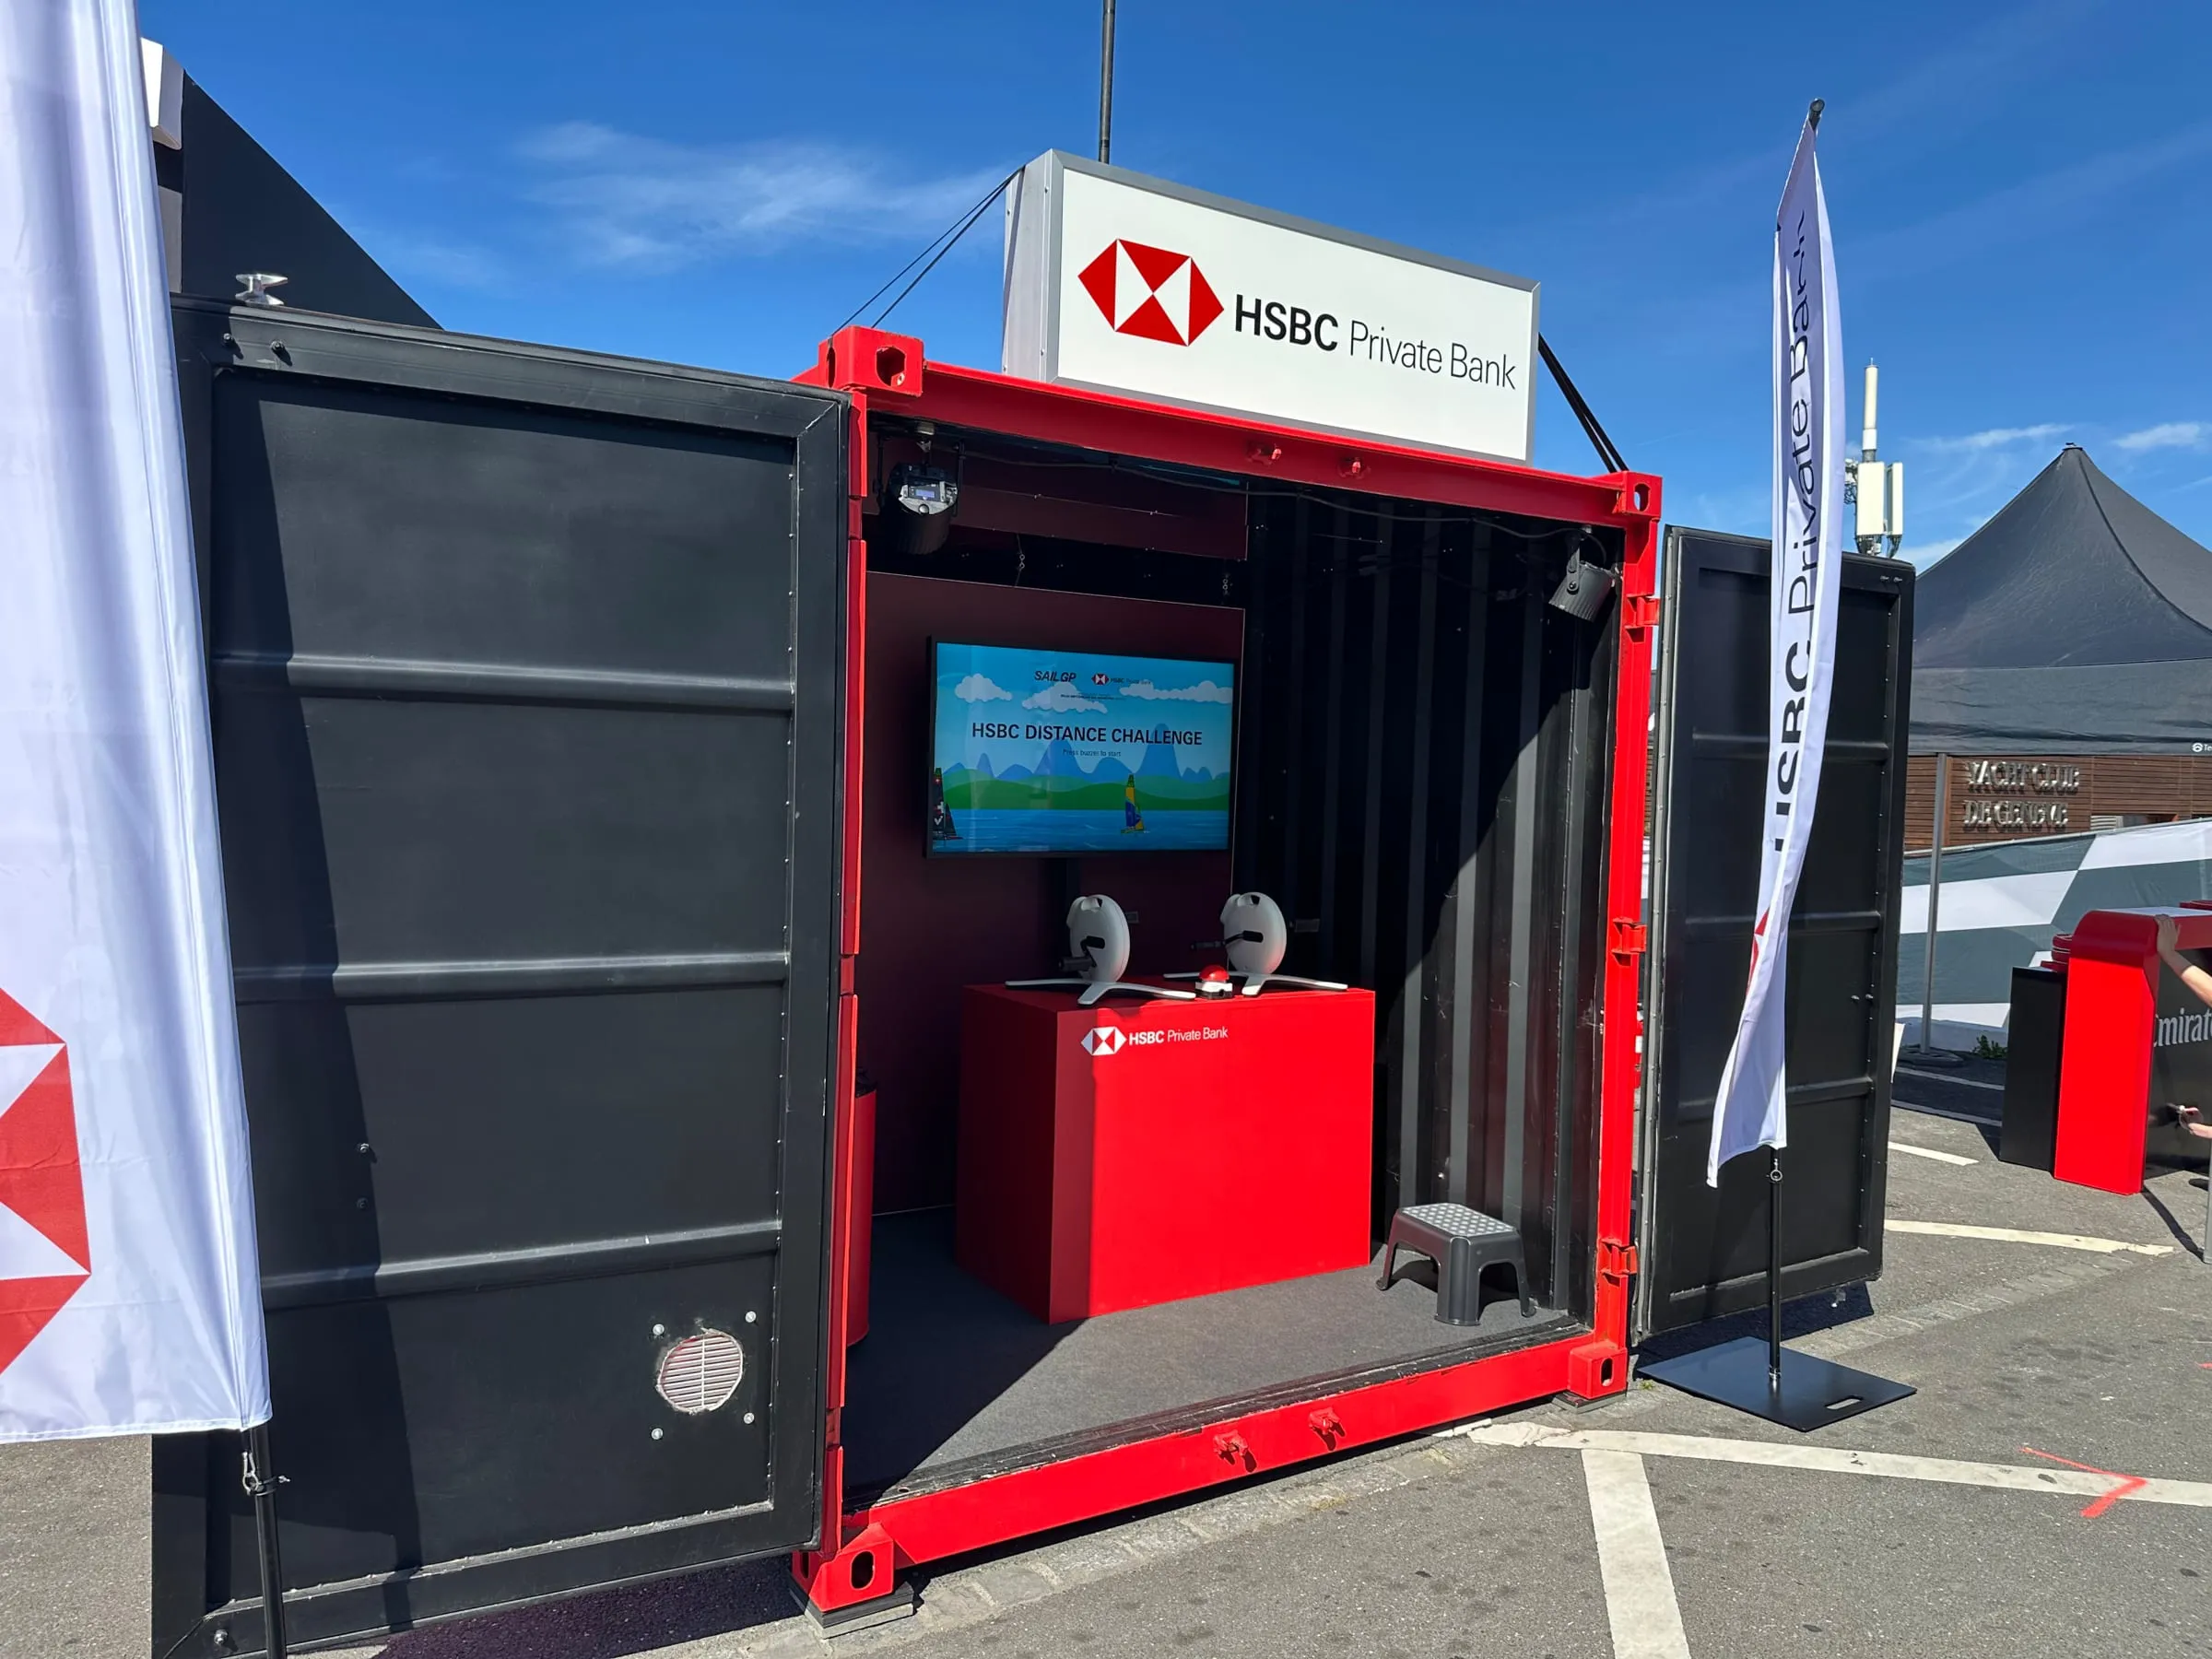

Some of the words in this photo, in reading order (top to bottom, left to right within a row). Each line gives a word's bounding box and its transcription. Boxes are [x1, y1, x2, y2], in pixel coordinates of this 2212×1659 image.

[1234, 294, 1338, 351] HSBC
[1349, 319, 1442, 374] Private
[1451, 344, 1516, 390] Bank
[1788, 399, 1818, 614] Private
[972, 723, 1020, 739] HSBC
[1025, 724, 1107, 742] DISTANCE
[1112, 728, 1203, 746] CHALLENGE
[1128, 1030, 1164, 1046] HSBC
[1167, 1029, 1200, 1042] Private
[1202, 1026, 1229, 1040] Bank
[2153, 1007, 2212, 1047] mirat
